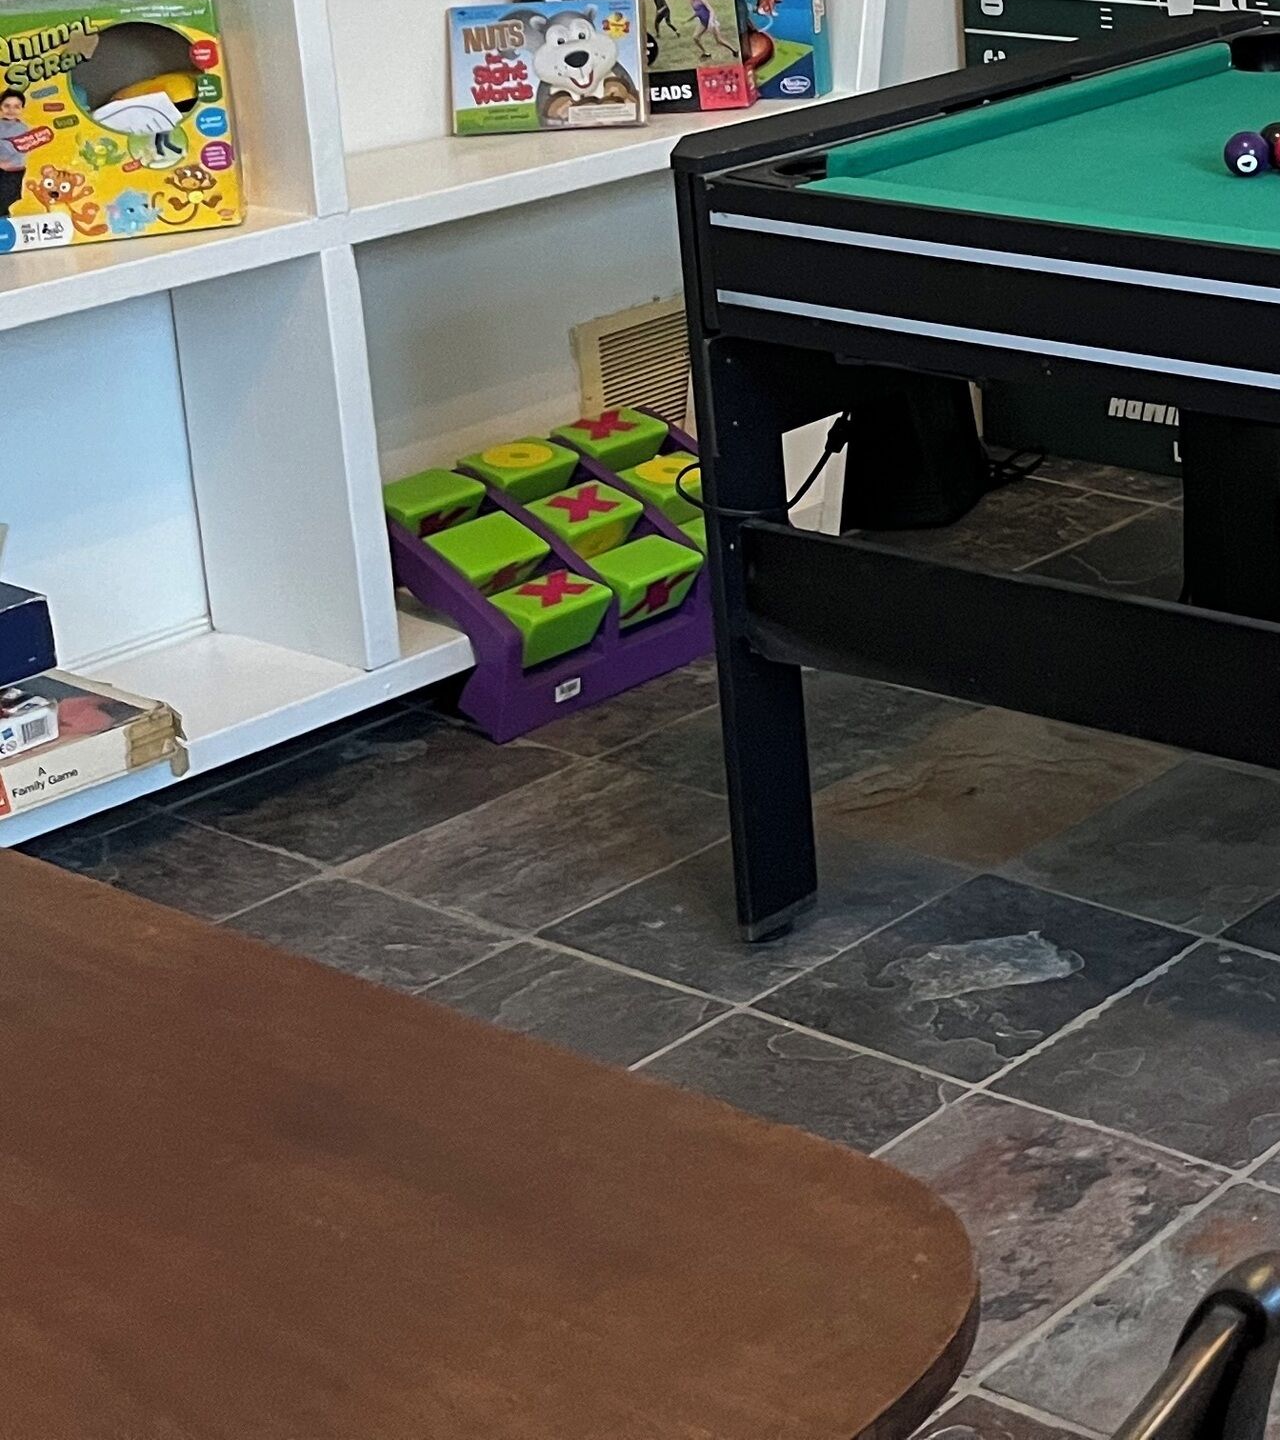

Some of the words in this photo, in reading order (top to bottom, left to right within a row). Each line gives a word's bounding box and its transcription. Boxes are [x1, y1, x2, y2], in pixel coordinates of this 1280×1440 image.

[461, 18, 526, 54] NUTS
[472, 60, 529, 87] Sight
[470, 81, 535, 106] Words
[650, 84, 694, 102] EADS
[11, 780, 46, 799] Family
[47, 767, 79, 786] Game
[37, 766, 48, 777] A
